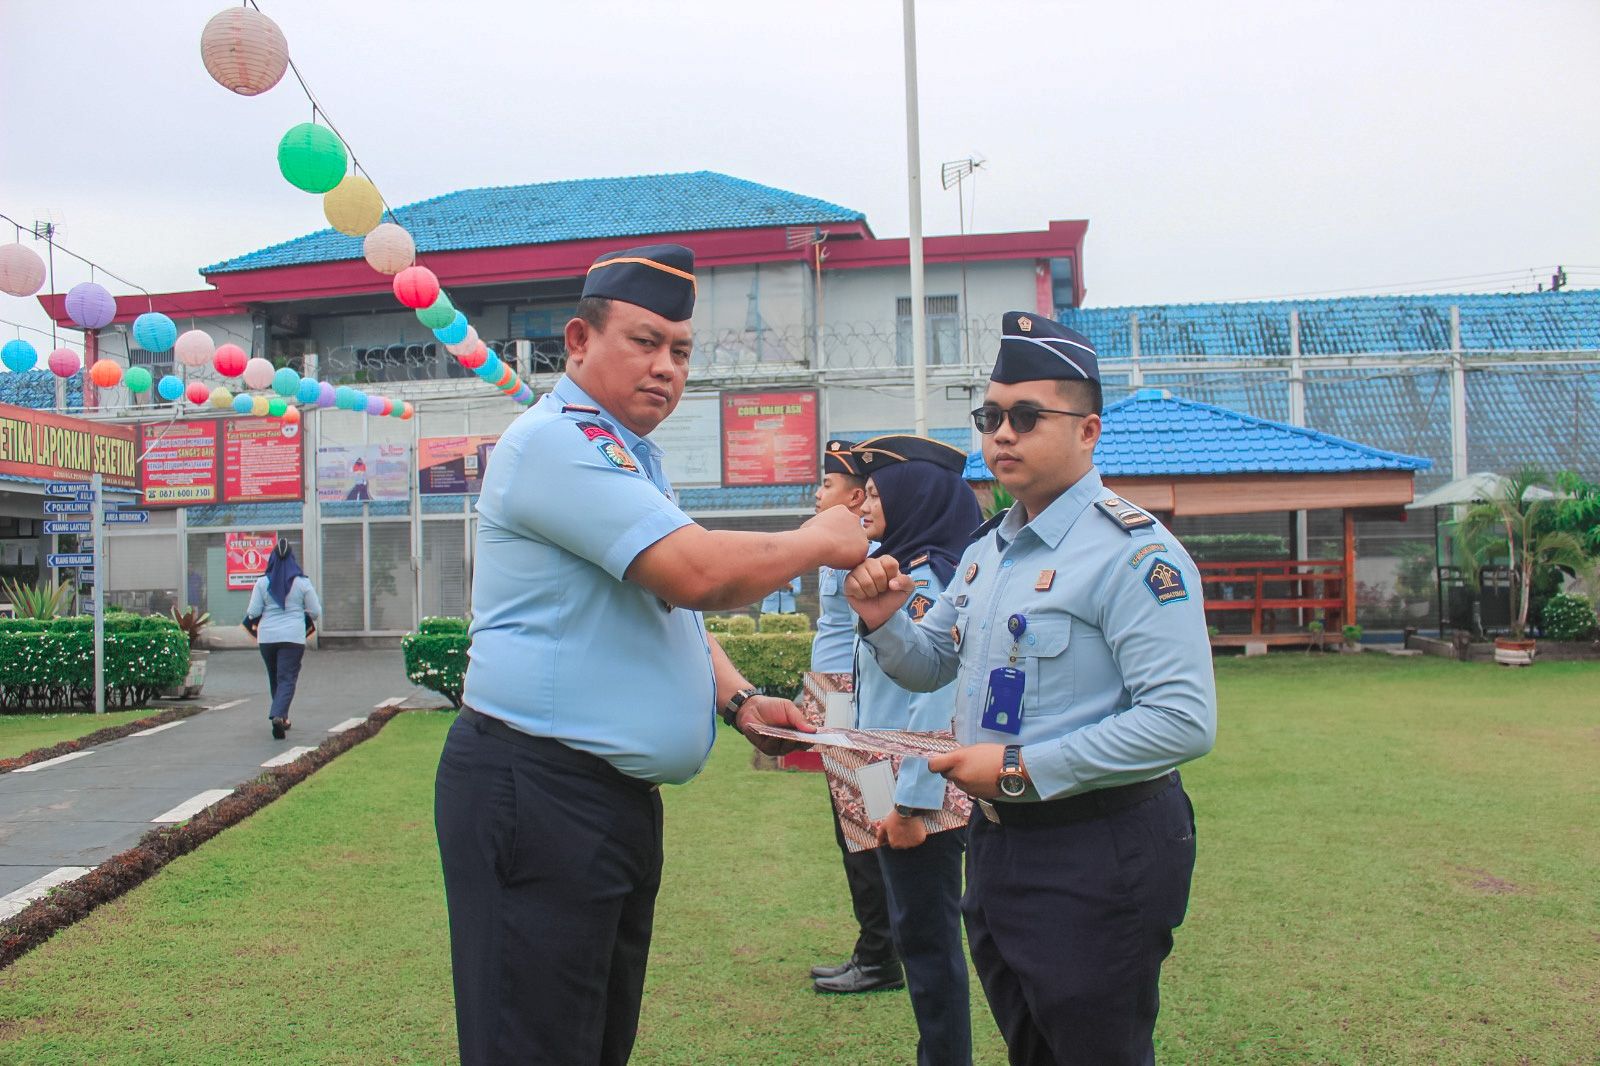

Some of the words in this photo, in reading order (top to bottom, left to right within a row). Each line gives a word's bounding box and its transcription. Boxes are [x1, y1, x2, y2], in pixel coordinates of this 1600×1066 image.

[36, 424, 91, 471] LAPORKAN
[94, 434, 136, 478] SEKETIKA
[53, 484, 67, 493] BLOK
[69, 484, 89, 492] WANITA
[80, 491, 93, 500] AULA
[52, 504, 89, 512] POLIKLINIK
[119, 513, 141, 521] MEROKOK
[52, 524, 69, 532] RUANG
[230, 540, 253, 548] STERIL
[256, 538, 273, 547] AREA
